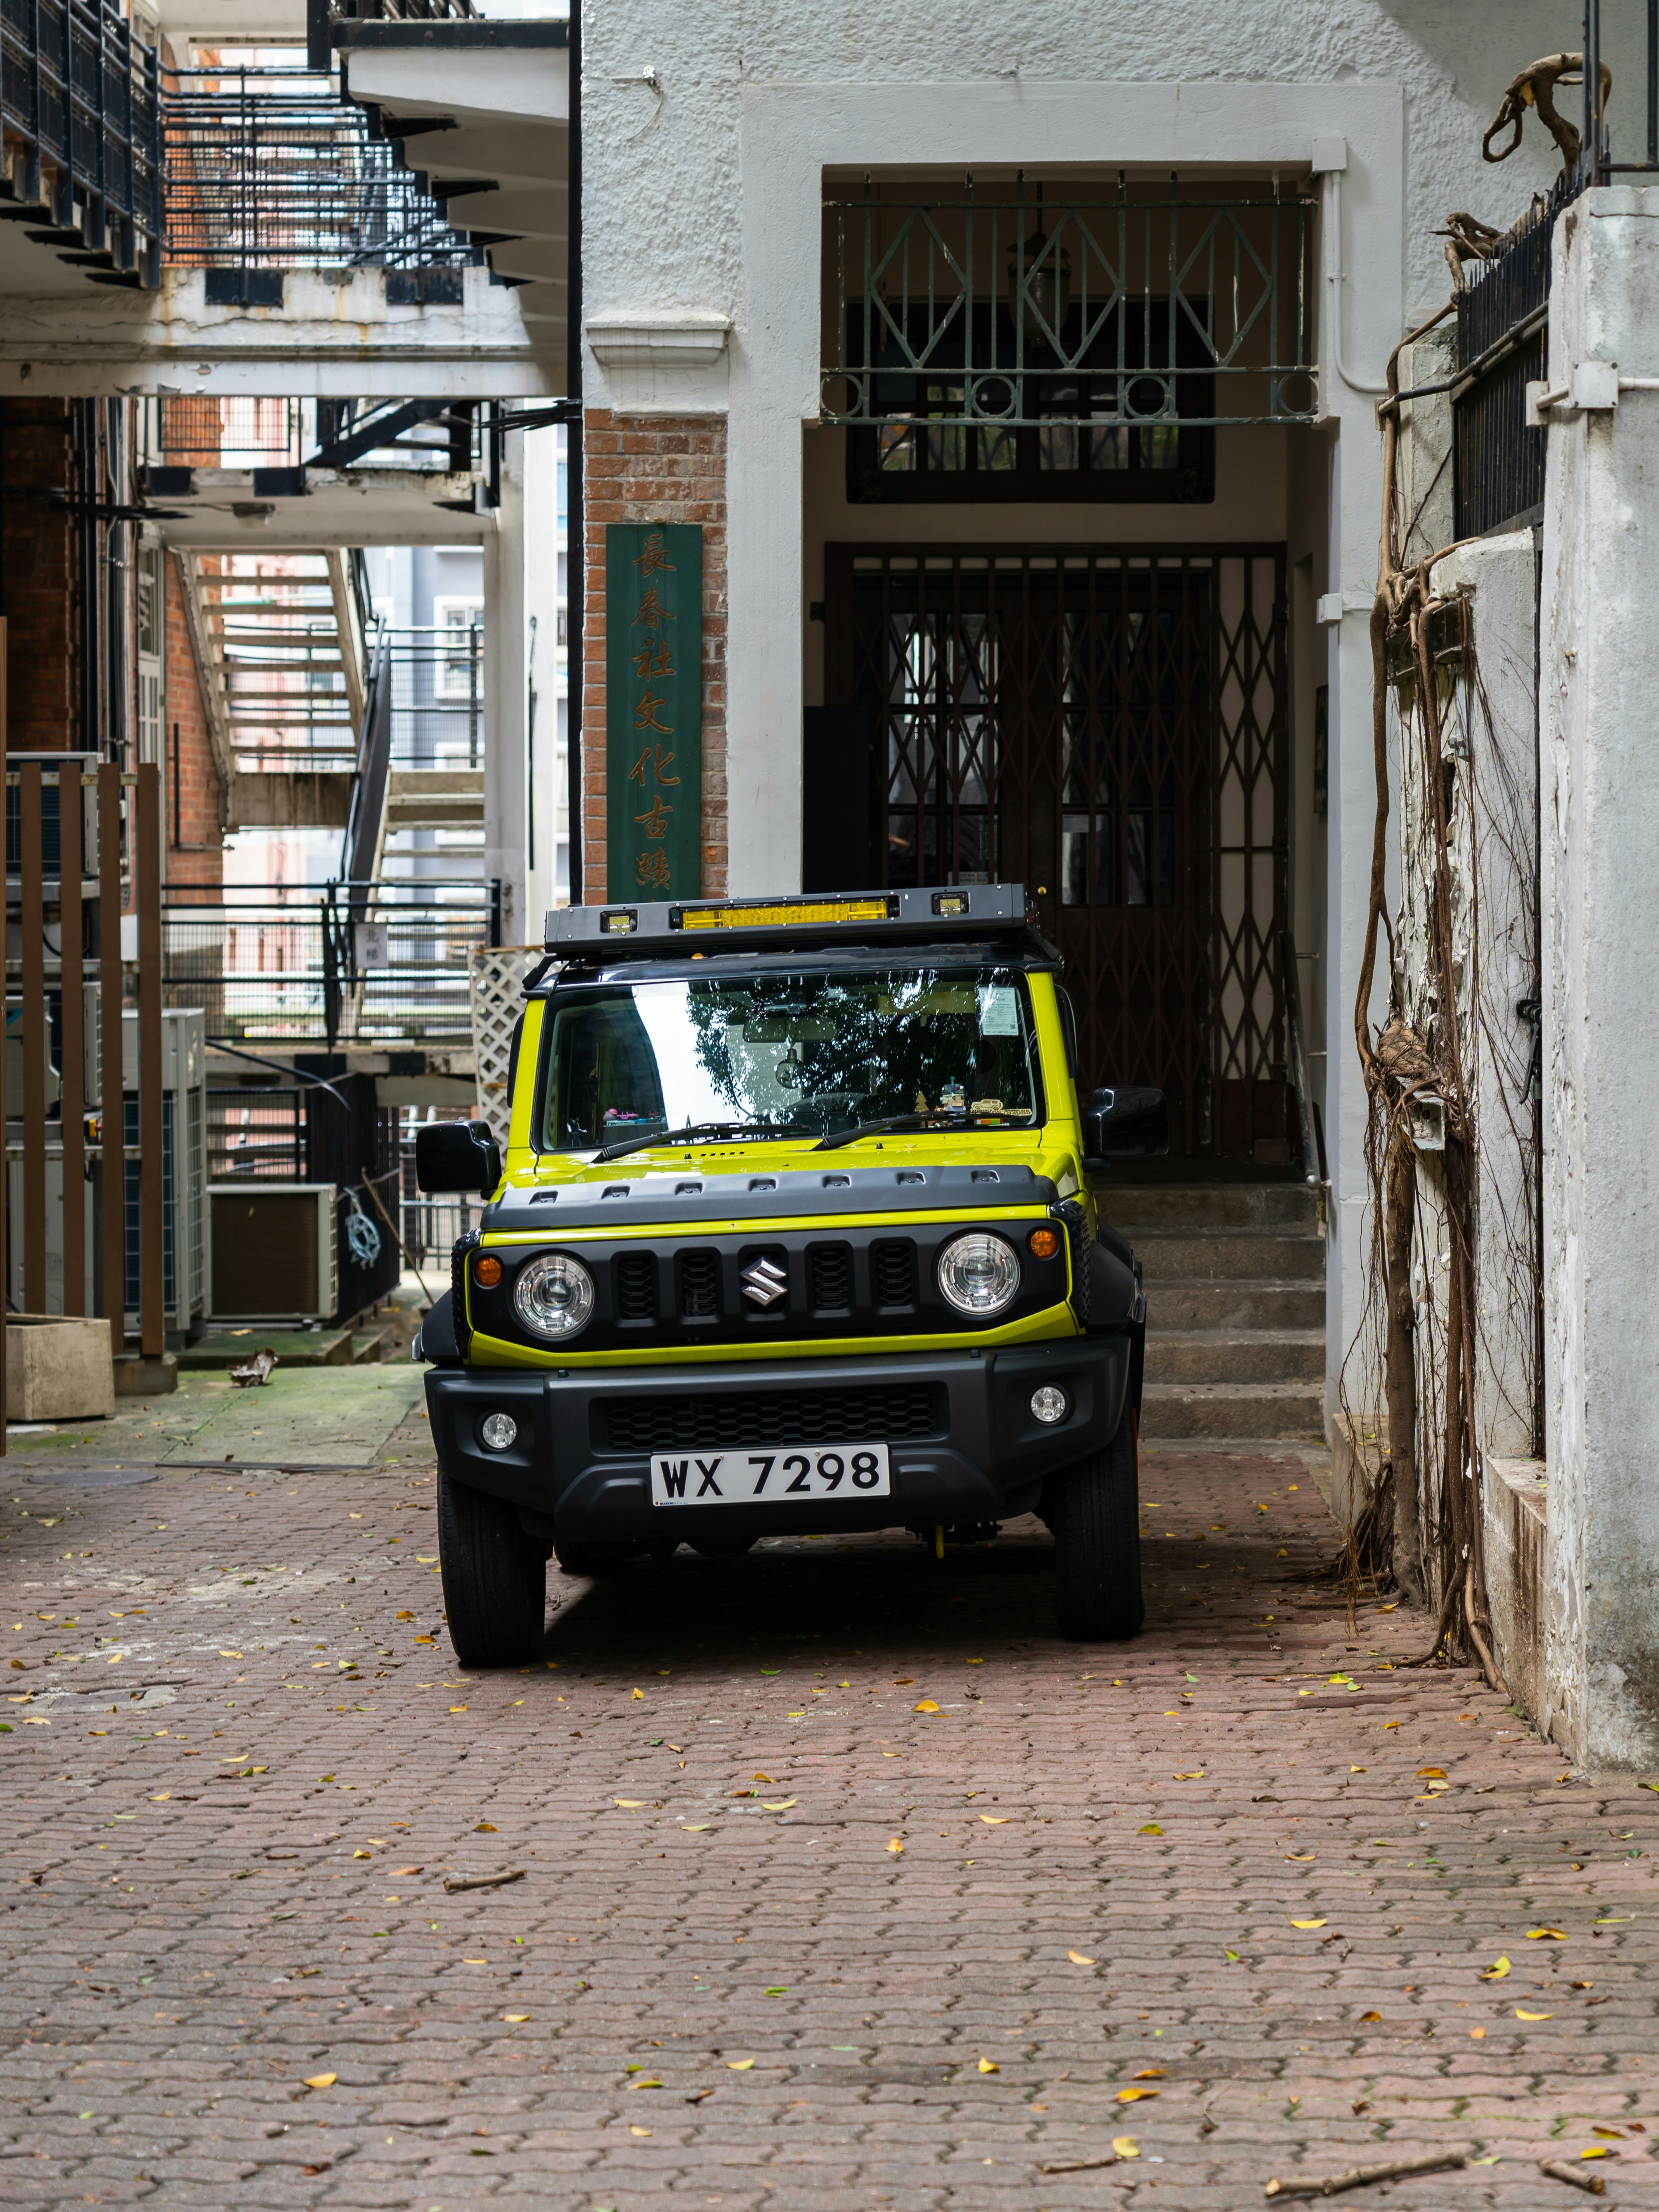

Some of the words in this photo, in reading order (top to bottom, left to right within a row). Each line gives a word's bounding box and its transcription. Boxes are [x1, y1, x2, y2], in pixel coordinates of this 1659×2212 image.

[628, 534, 681, 902] 長春社文化古蹟
[660, 1458, 724, 1498] WX
[748, 1451, 880, 1495] 7298
